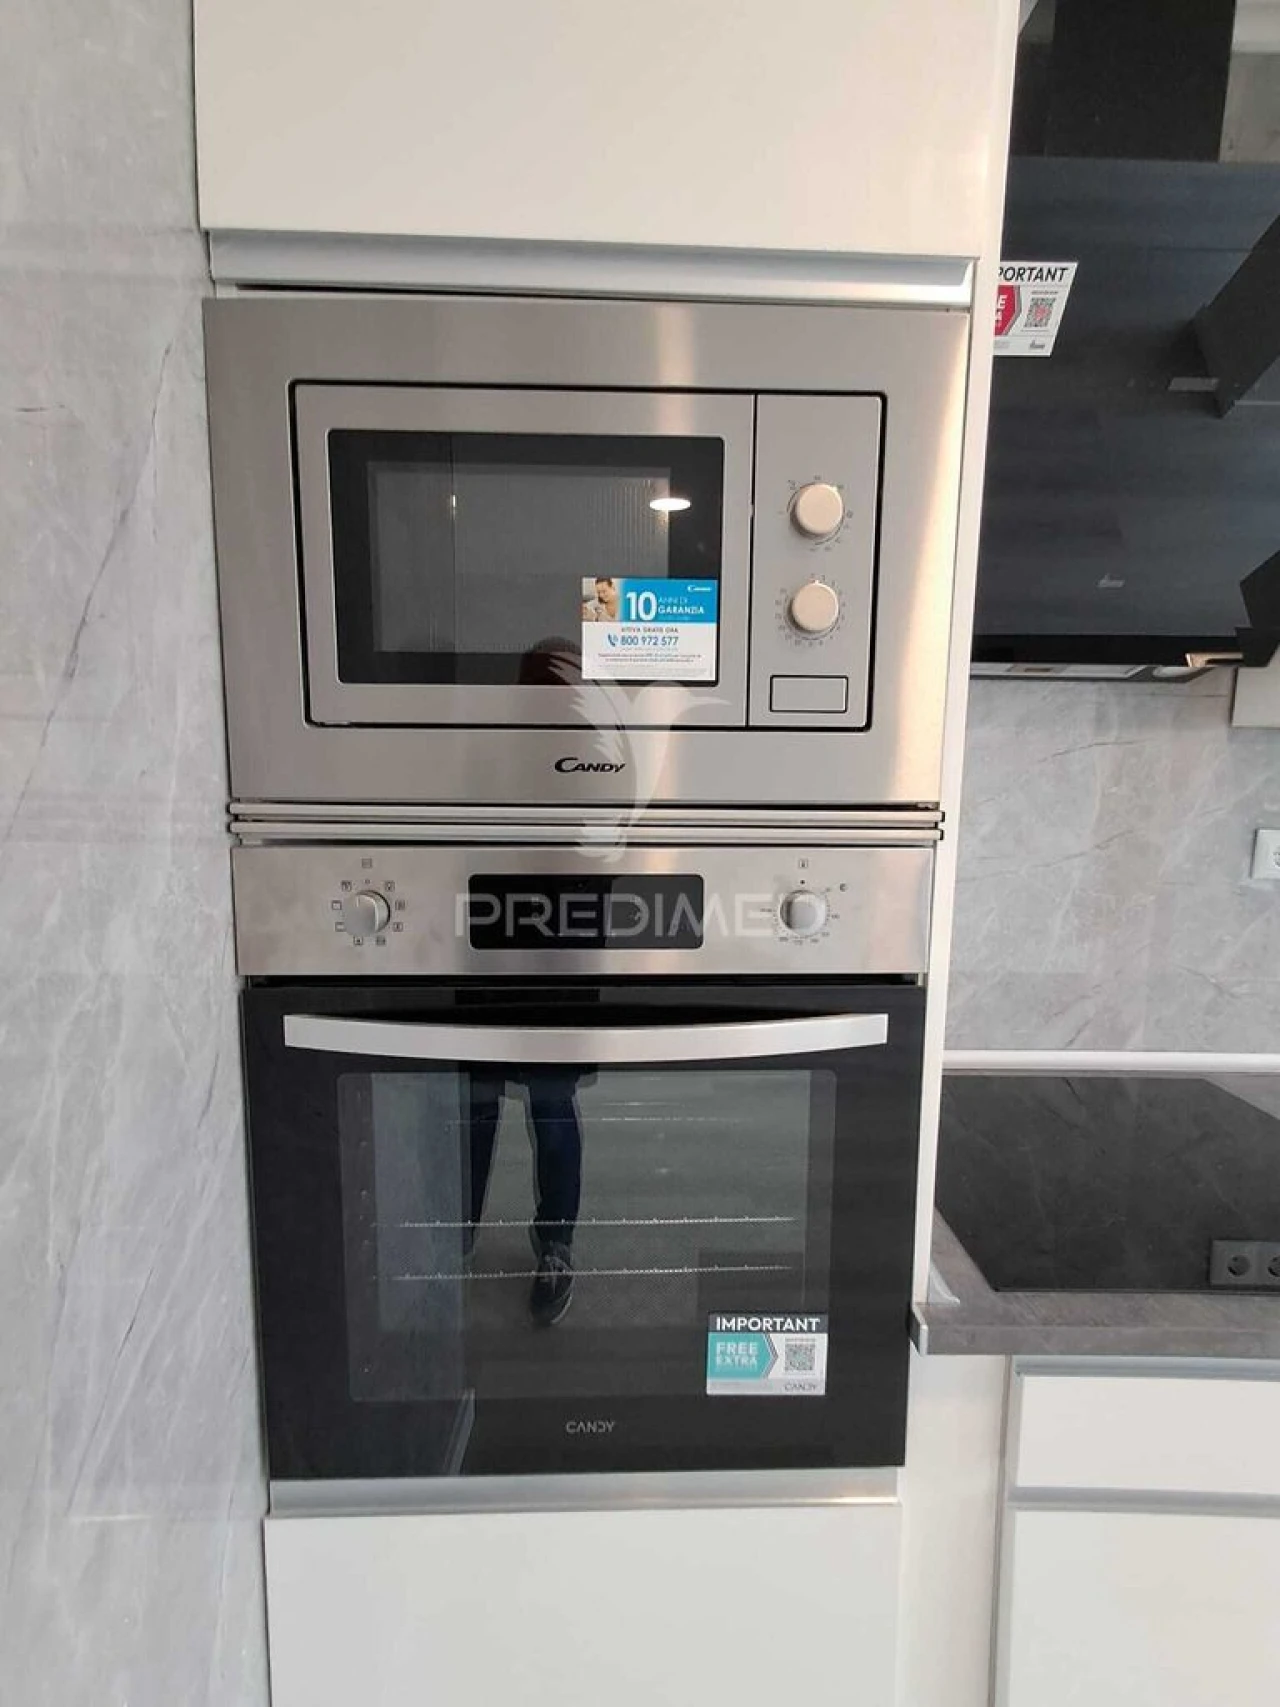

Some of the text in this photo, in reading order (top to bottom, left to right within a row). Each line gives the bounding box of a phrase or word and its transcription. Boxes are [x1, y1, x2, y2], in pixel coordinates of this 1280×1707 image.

[626, 591, 657, 620] 10
[621, 635, 679, 646] 800 972 577
[716, 1317, 820, 1331] IMPORTANT
[716, 1341, 759, 1355] FREE
[716, 1355, 759, 1367] EXTRA
[566, 1421, 616, 1433] CANDY
